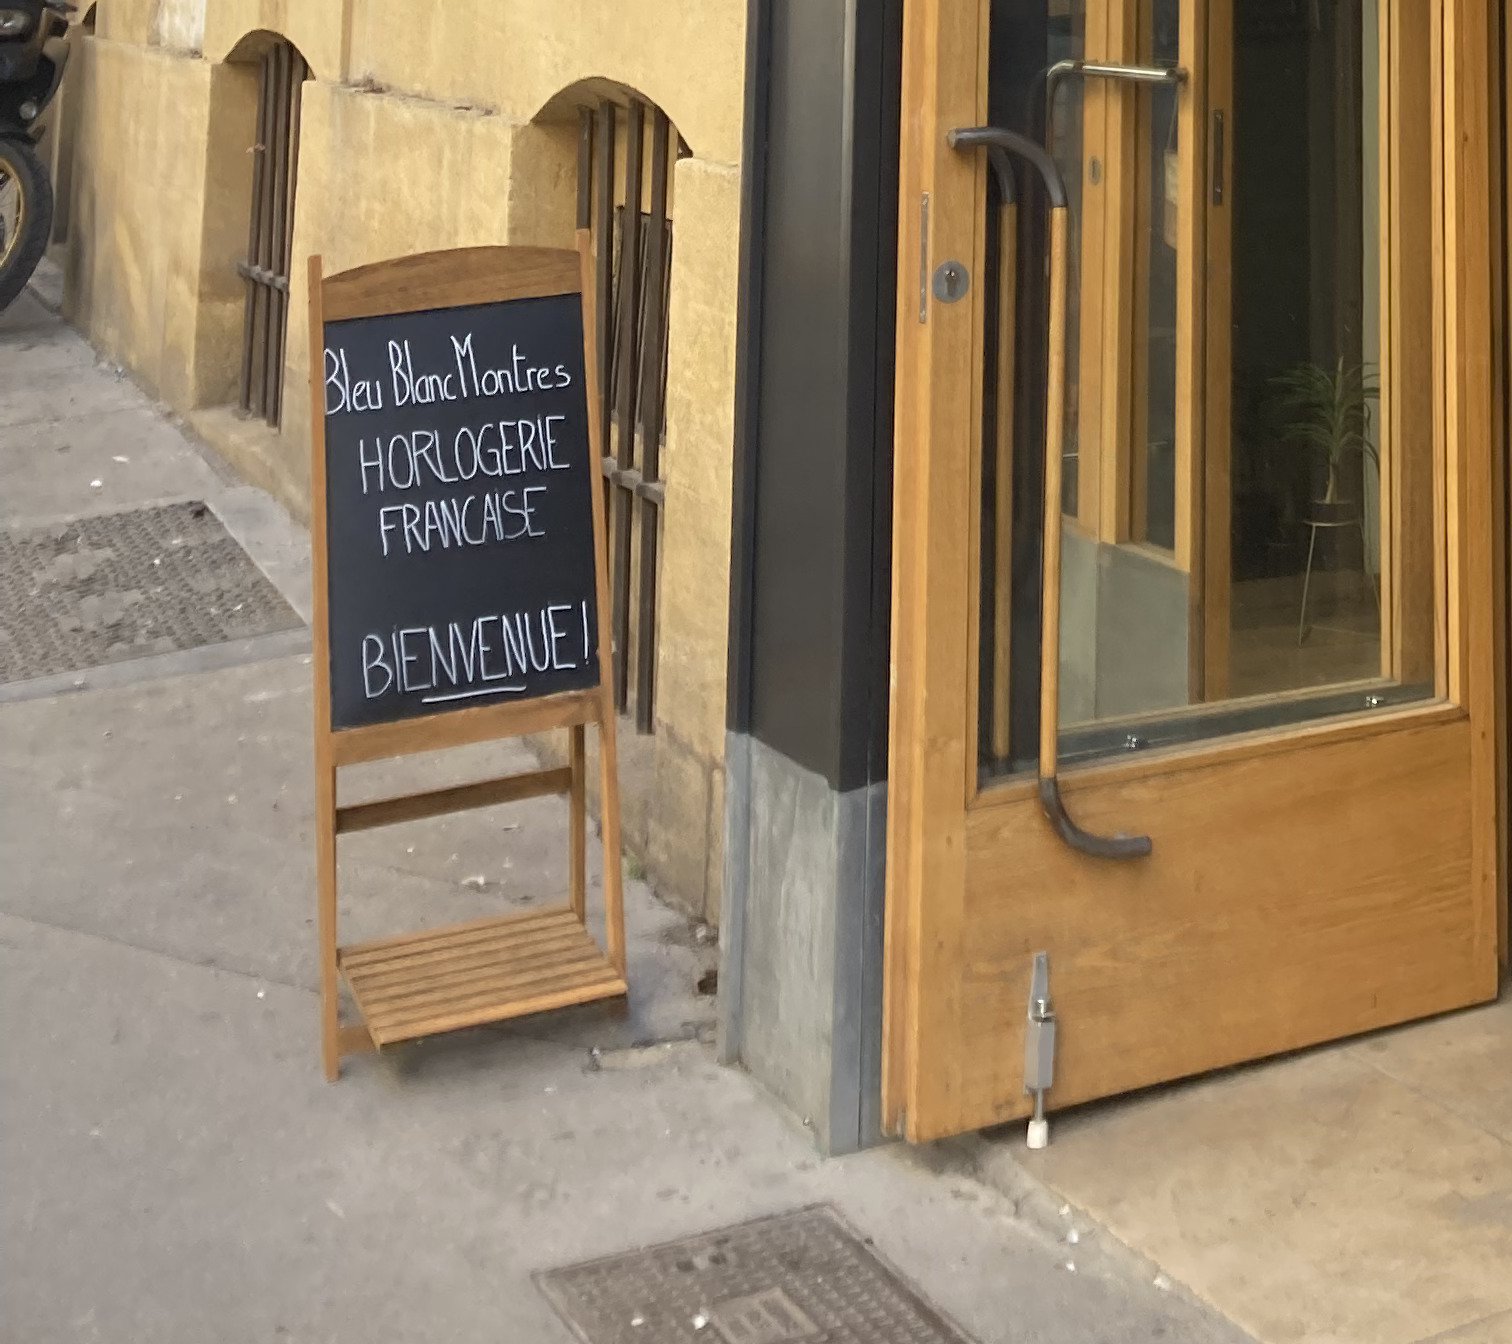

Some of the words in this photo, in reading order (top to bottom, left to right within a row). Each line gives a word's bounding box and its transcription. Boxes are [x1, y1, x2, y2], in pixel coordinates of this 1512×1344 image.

[323, 347, 382, 416] Bleu
[387, 339, 456, 408] Blanc
[450, 332, 572, 401] Montres
[358, 414, 571, 495] HORLOGERIE
[379, 486, 548, 556] FRANCAISE
